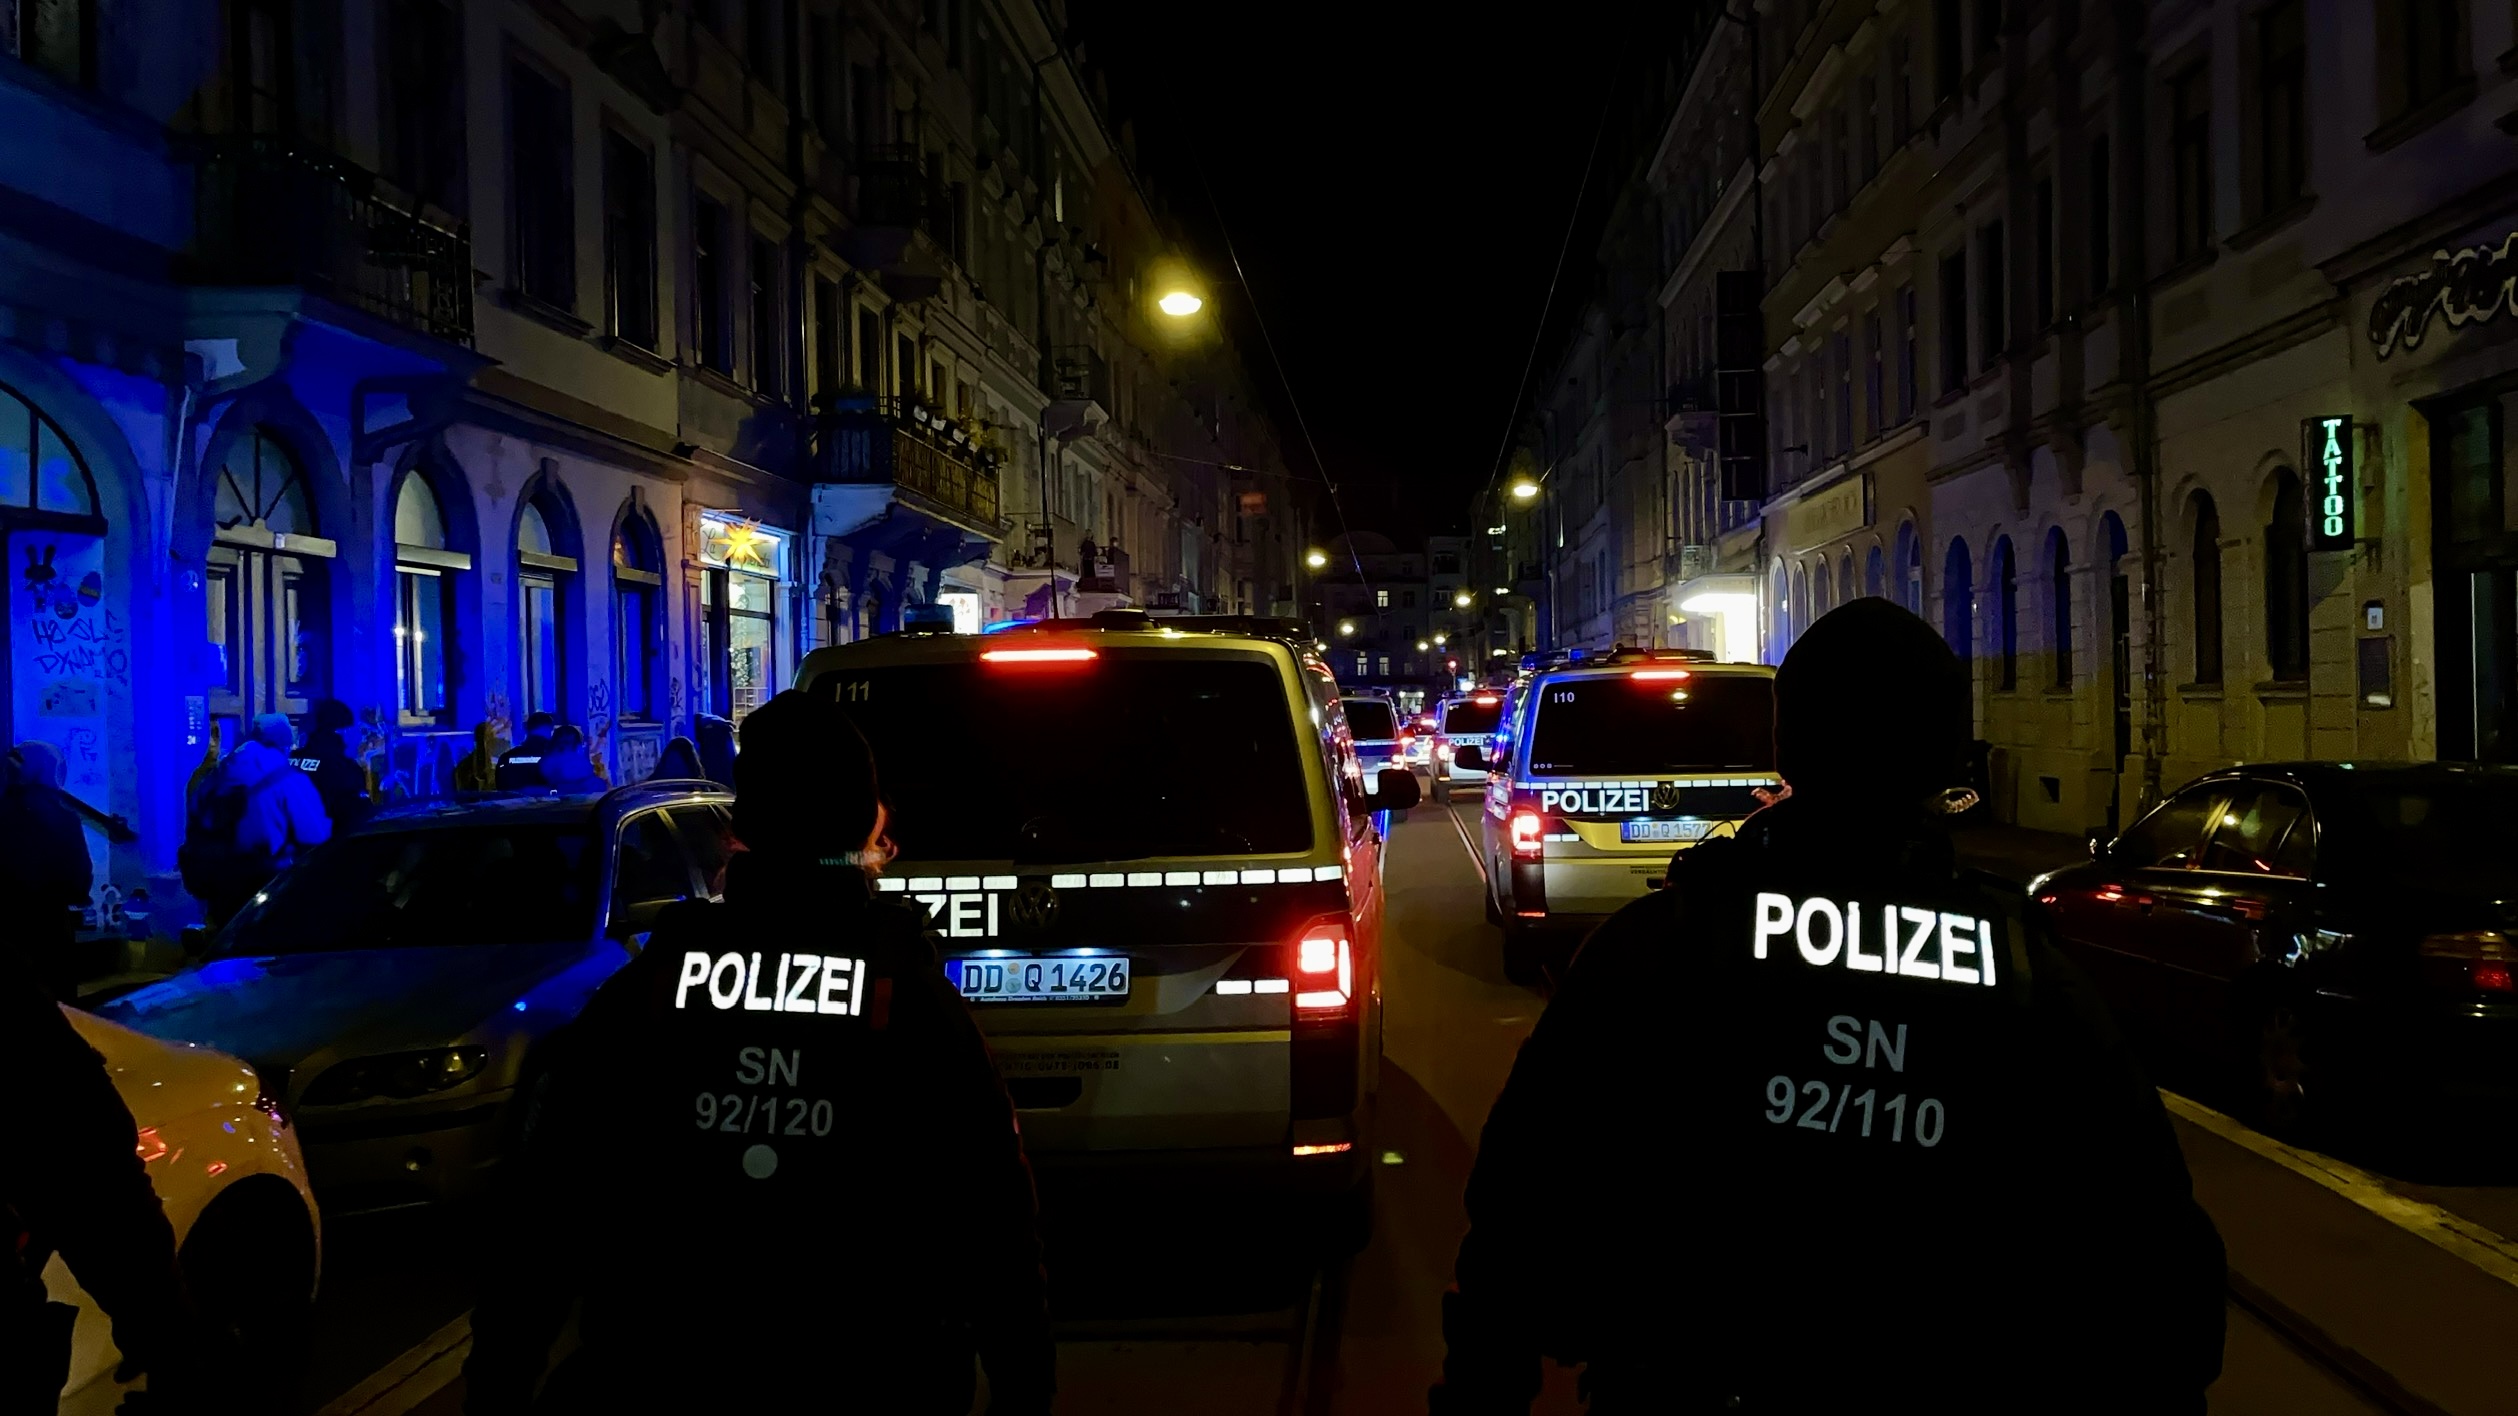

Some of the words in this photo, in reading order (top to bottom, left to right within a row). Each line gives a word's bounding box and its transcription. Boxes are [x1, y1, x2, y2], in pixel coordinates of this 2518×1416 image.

[2323, 419, 2344, 536] TATTOO
[1449, 737, 1484, 746] POLIZEI
[1542, 789, 1650, 813] POLIZEI
[1631, 824, 1650, 838] DD
[1661, 823, 1670, 837] Q
[1674, 822, 1711, 838] 1577
[1753, 891, 1996, 986] POLIZEI
[675, 951, 866, 1017] POLIZEI
[963, 965, 1003, 993] DD
[1025, 963, 1042, 992] Q
[1051, 963, 1125, 992] 1426
[1823, 1014, 1908, 1072] SN
[736, 1046, 801, 1087] SN
[695, 1091, 834, 1137] 92/120
[1765, 1074, 1945, 1147] 92/110
